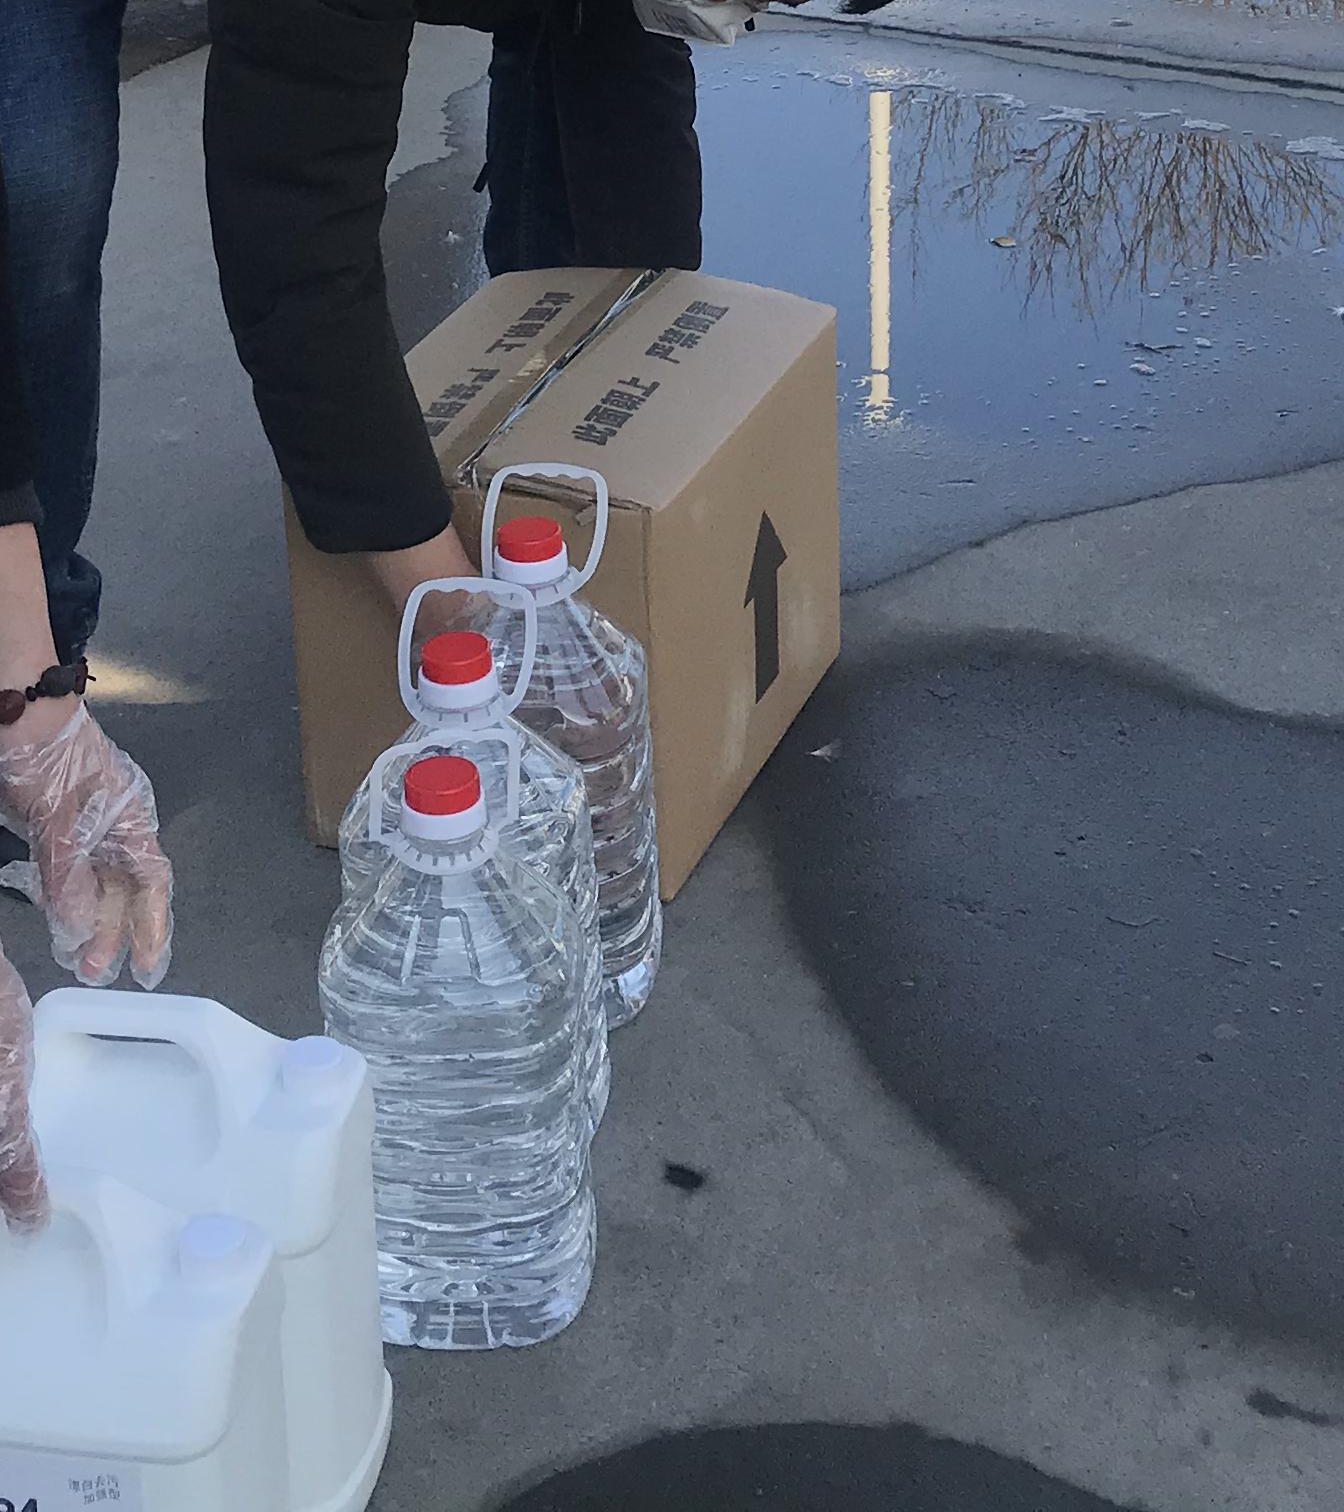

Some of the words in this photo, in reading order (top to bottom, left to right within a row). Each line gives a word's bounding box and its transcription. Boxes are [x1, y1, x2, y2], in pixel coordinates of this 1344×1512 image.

[571, 376, 661, 446] 此面朝上
[645, 300, 730, 364] 严禁侧置
